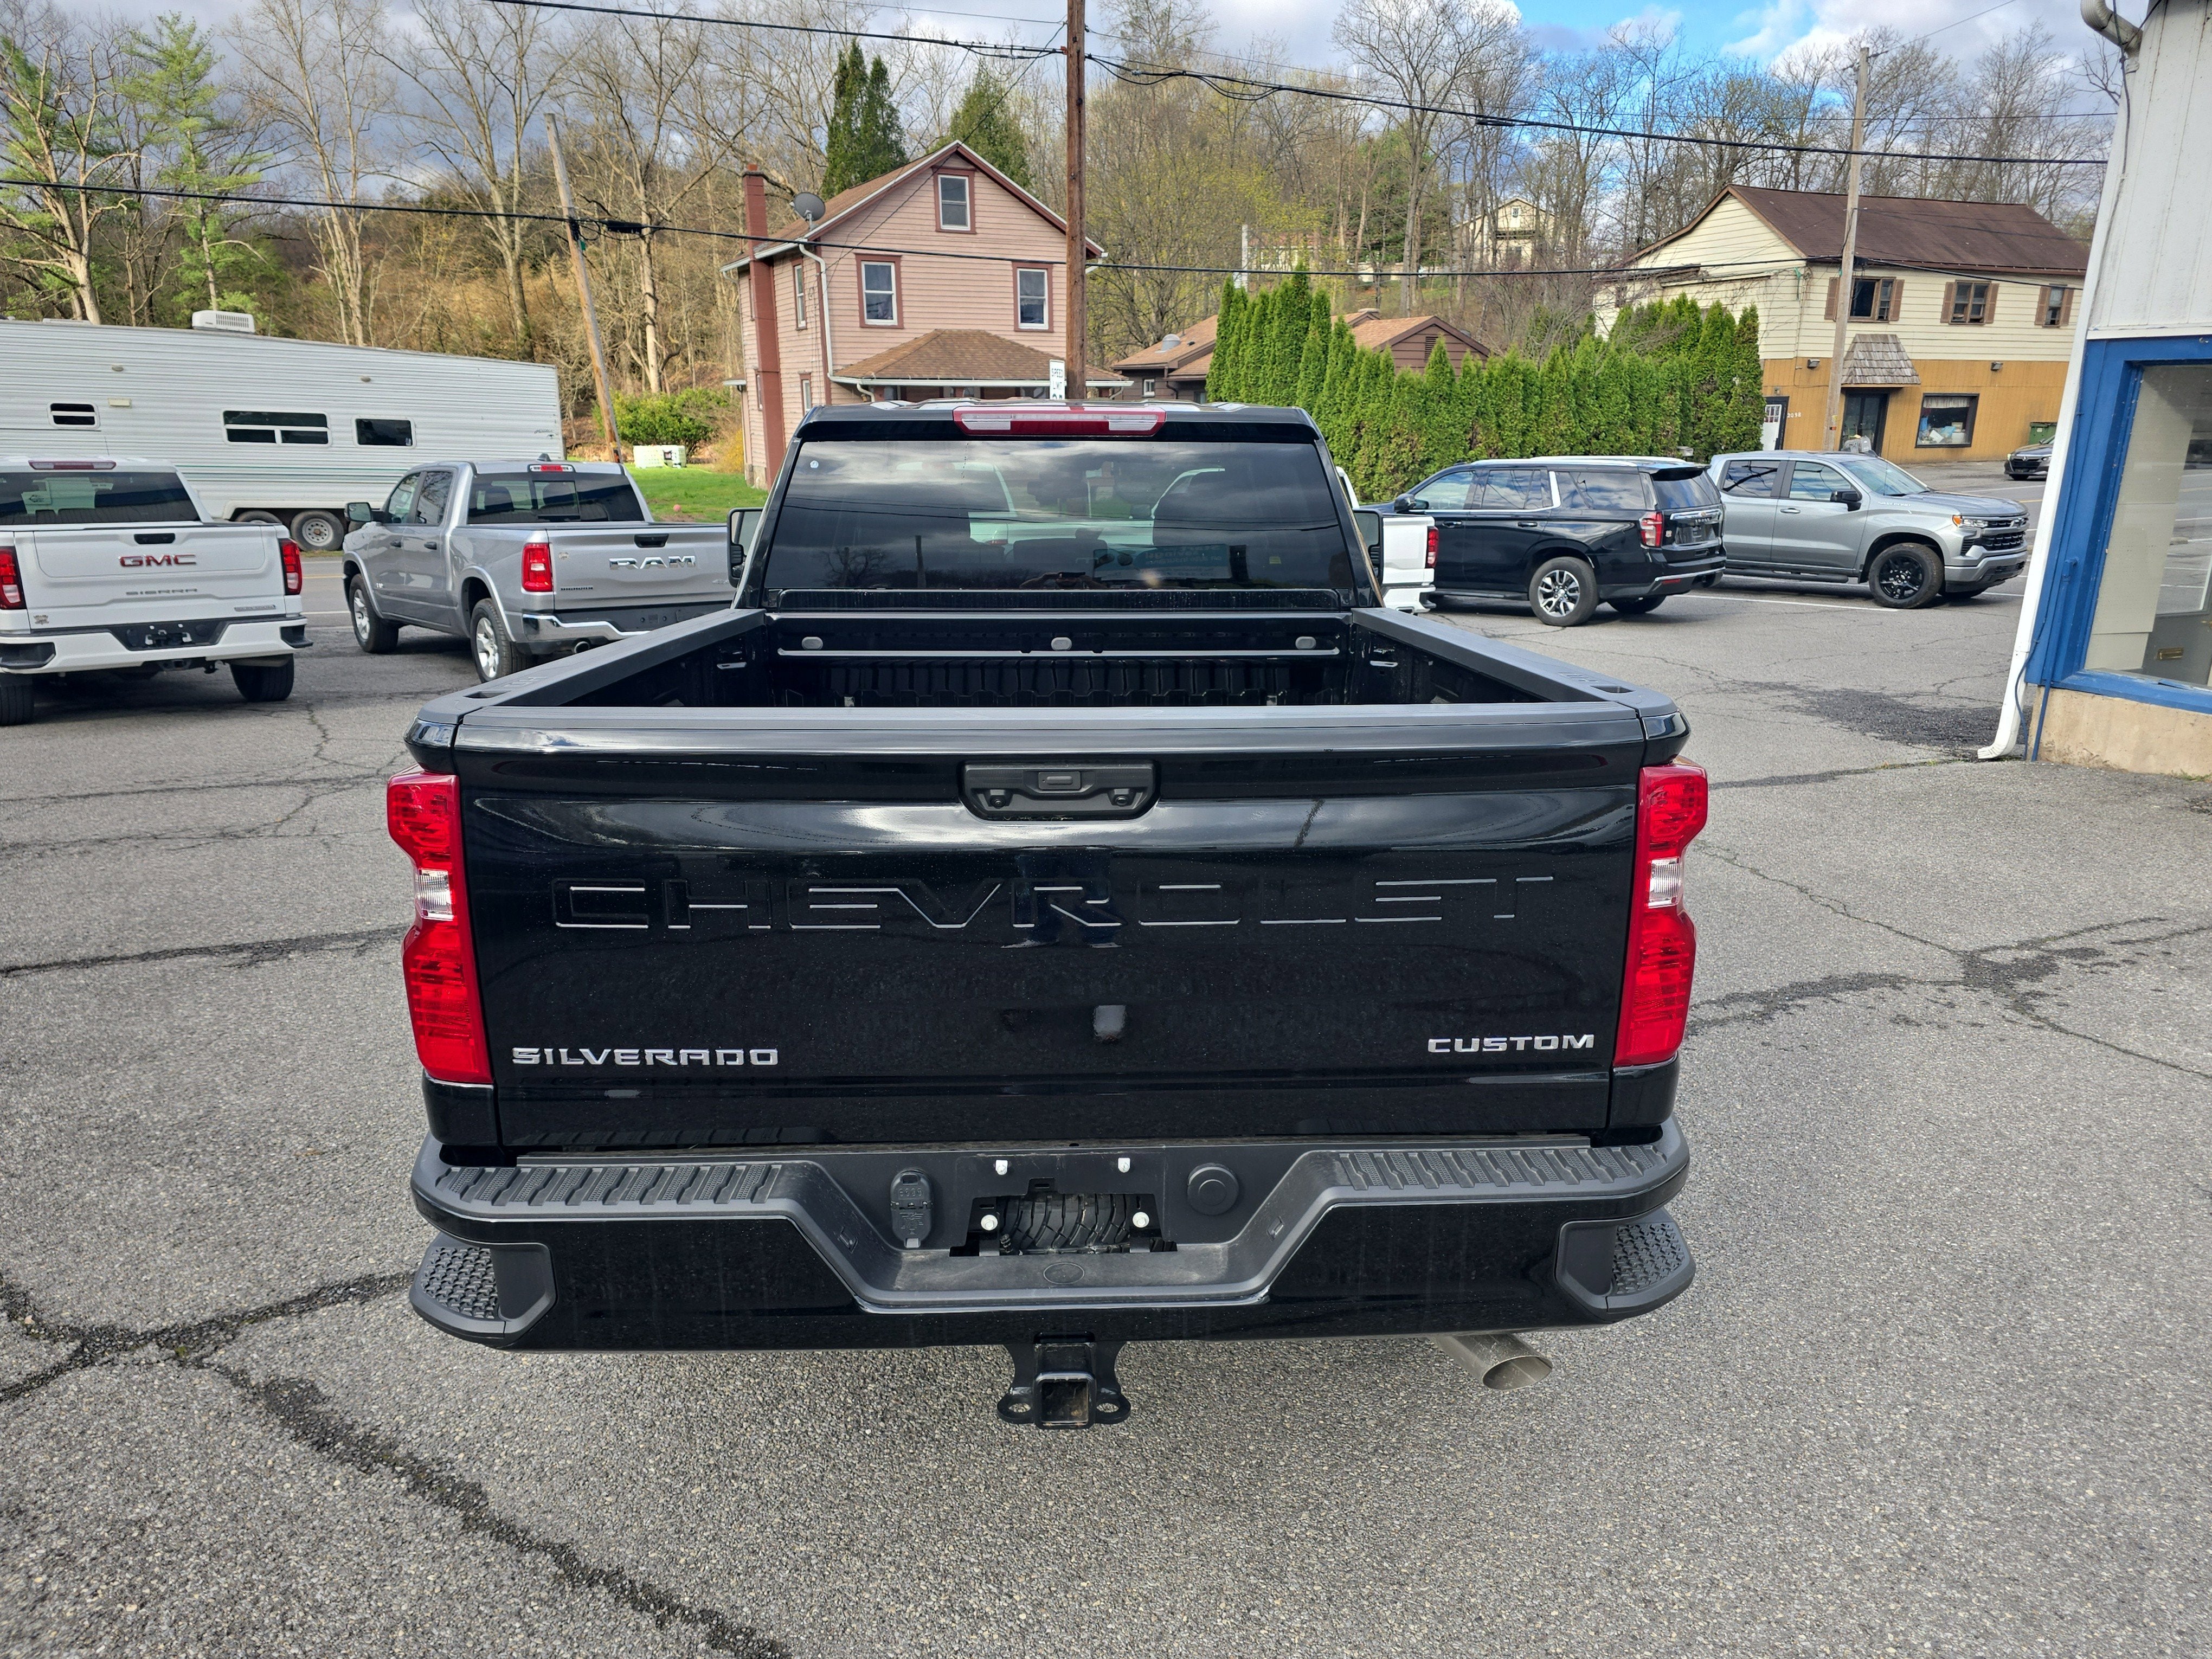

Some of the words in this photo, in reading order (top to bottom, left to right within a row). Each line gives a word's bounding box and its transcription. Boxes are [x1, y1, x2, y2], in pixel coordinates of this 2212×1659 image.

[1052, 368, 1063, 378] SPEED
[118, 554, 197, 567] GMC
[609, 556, 696, 570] RAM
[551, 869, 1555, 929] CHEVROLET
[1427, 1034, 1594, 1053] CUSTOM
[512, 1047, 779, 1065] SILVERADO
